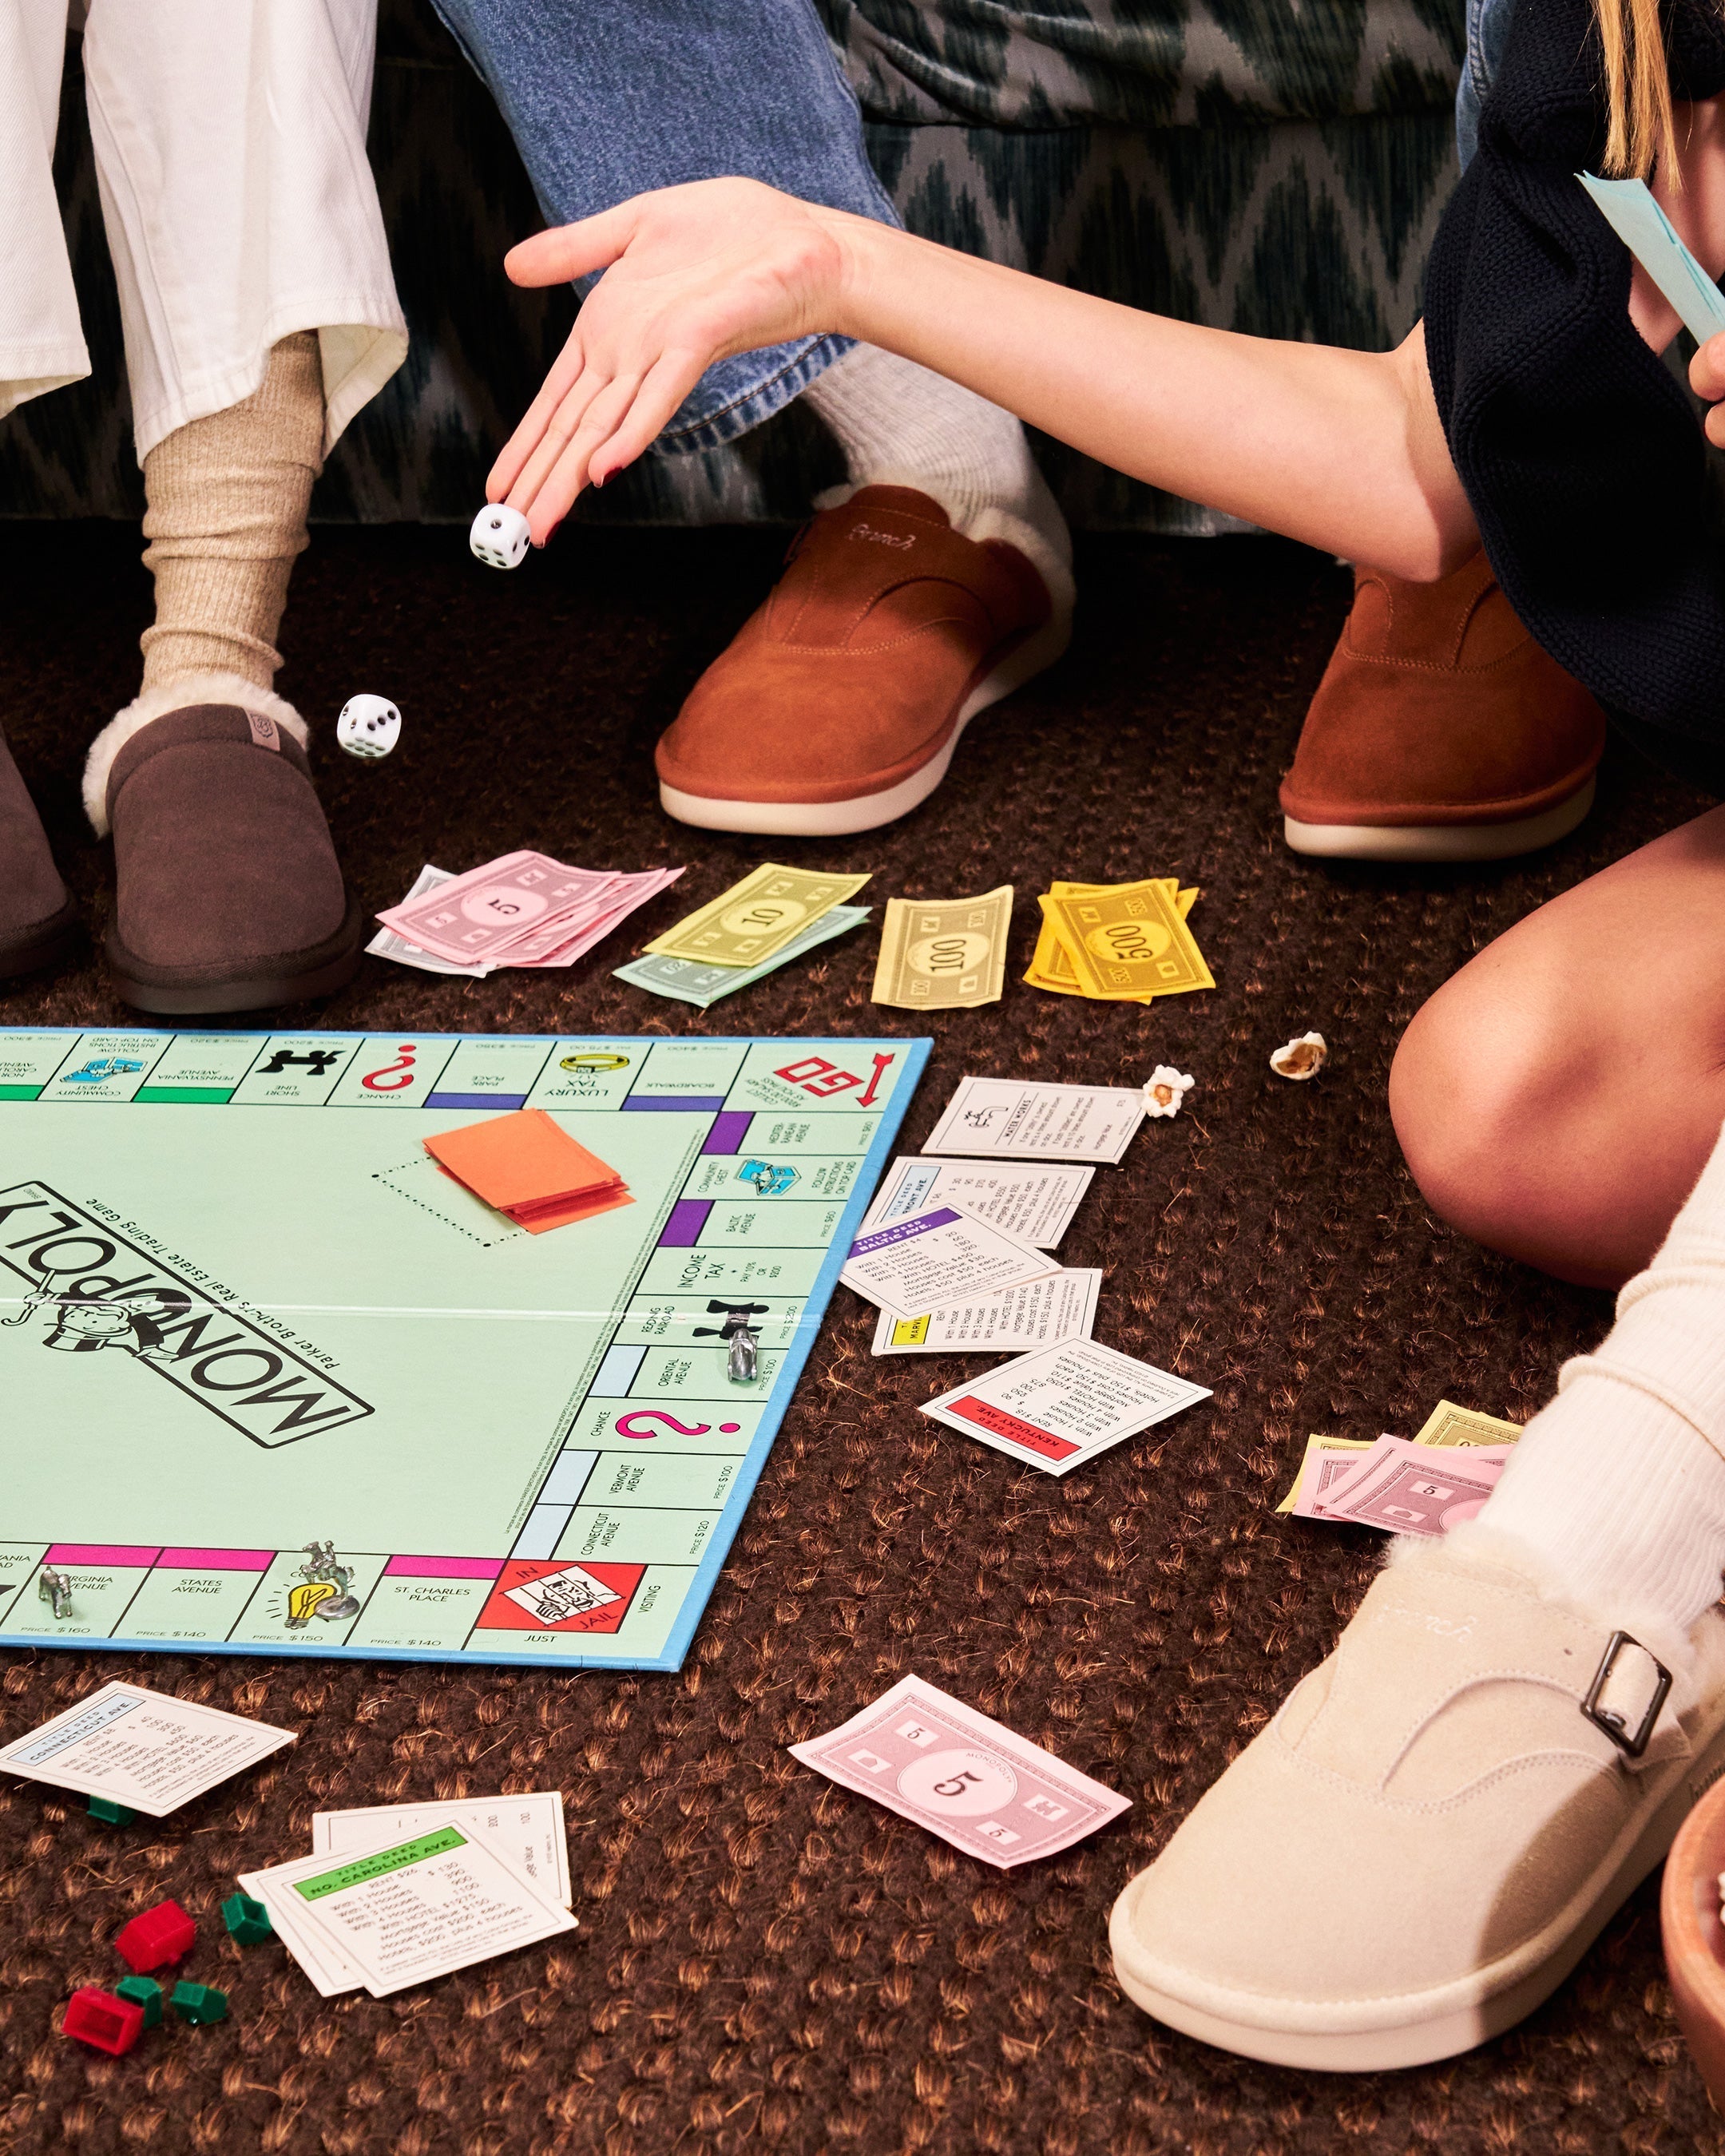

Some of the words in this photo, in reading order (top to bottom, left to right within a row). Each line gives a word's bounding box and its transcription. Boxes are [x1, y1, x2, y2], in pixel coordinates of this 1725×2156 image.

[488, 899, 520, 914] 5
[742, 909, 783, 926] 10
[1105, 925, 1153, 960] 500
[930, 939, 966, 972] 100
[772, 1056, 866, 1098] GO
[843, 1162, 856, 1174] CARD
[697, 1162, 716, 1192] COMMUNITY
[714, 1169, 728, 1185] CHEST
[811, 1168, 827, 1188] FOLLOW
[823, 1162, 843, 1194] INSTRUCTIONS
[839, 1175, 850, 1185] TOP
[86, 1199, 121, 1221] Game
[902, 1193, 918, 1214] RMONT
[726, 1215, 742, 1232] BALTIC
[740, 1214, 755, 1234] AVENUE
[824, 1211, 836, 1223] $60
[120, 1222, 168, 1254] Trading
[856, 1233, 889, 1246] TITLE
[893, 1221, 921, 1233] DEED
[859, 1234, 902, 1251] BALTIC
[906, 1224, 931, 1235] AVE.
[168, 1254, 209, 1281] Estate
[677, 1254, 706, 1287] INCOME
[704, 1263, 725, 1279] TAX
[745, 1262, 756, 1272] 10%
[769, 1266, 781, 1278] $200
[204, 1282, 239, 1302] Real
[0, 1200, 351, 1435] MONOPOLY
[239, 1302, 295, 1339] Brothers
[294, 1340, 340, 1369] Parker
[763, 1359, 776, 1374] $100
[1055, 1364, 1074, 1373] each
[1058, 1357, 1085, 1370] houses
[658, 1358, 679, 1386] ORIENTAL
[674, 1361, 692, 1385] AVENUE
[1092, 1372, 1110, 1381] plus
[759, 1377, 770, 1390] PRICE
[1073, 1381, 1092, 1391] Value
[1069, 1396, 1096, 1410] Houses
[1073, 1389, 1097, 1401] HOTEL
[1094, 1390, 1128, 1407] Mortgage
[1116, 1391, 1144, 1405] Houses
[977, 1405, 999, 1418] AVE.
[1049, 1405, 1077, 1420] Houses
[1059, 1401, 1086, 1415] Houses
[1098, 1401, 1115, 1410] With
[590, 1412, 611, 1436] CHANCE
[978, 1417, 1005, 1431] DEED
[1031, 1417, 1053, 1427] RENT
[1043, 1413, 1068, 1425] House
[1094, 1417, 1111, 1427] With
[1104, 1412, 1120, 1421] With
[999, 1419, 1060, 1447] KENTUCKY
[1075, 1427, 1092, 1437] With
[1085, 1421, 1101, 1432] With
[1008, 1431, 1036, 1445] TITLE
[609, 1464, 631, 1493] VERMONT
[626, 1468, 645, 1492] AVENUE
[718, 1466, 732, 1482] $100
[713, 1484, 726, 1499] PRICE
[1423, 1485, 1438, 1495] 5
[581, 1512, 609, 1555] CONNECTICUT
[601, 1523, 620, 1547] AVENUE
[695, 1521, 709, 1537] $120
[689, 1540, 702, 1554] PRICE
[69, 1574, 114, 1584] IRGINIA
[515, 1566, 539, 1579] IN
[70, 1583, 109, 1591] VENUE
[414, 1587, 470, 1596] CHARLES
[638, 1584, 661, 1614] VISITING
[577, 1611, 619, 1631] JAIL
[30, 1716, 105, 1760] CONNECTICUT
[109, 1702, 129, 1715] AVE.
[907, 1727, 925, 1739] 5
[966, 1752, 1010, 1781] MONOPOLY
[934, 1771, 982, 1796] 5
[311, 1885, 336, 1894] NO.
[341, 1853, 418, 1883] CAROLINA
[424, 1840, 455, 1853] AVE.
